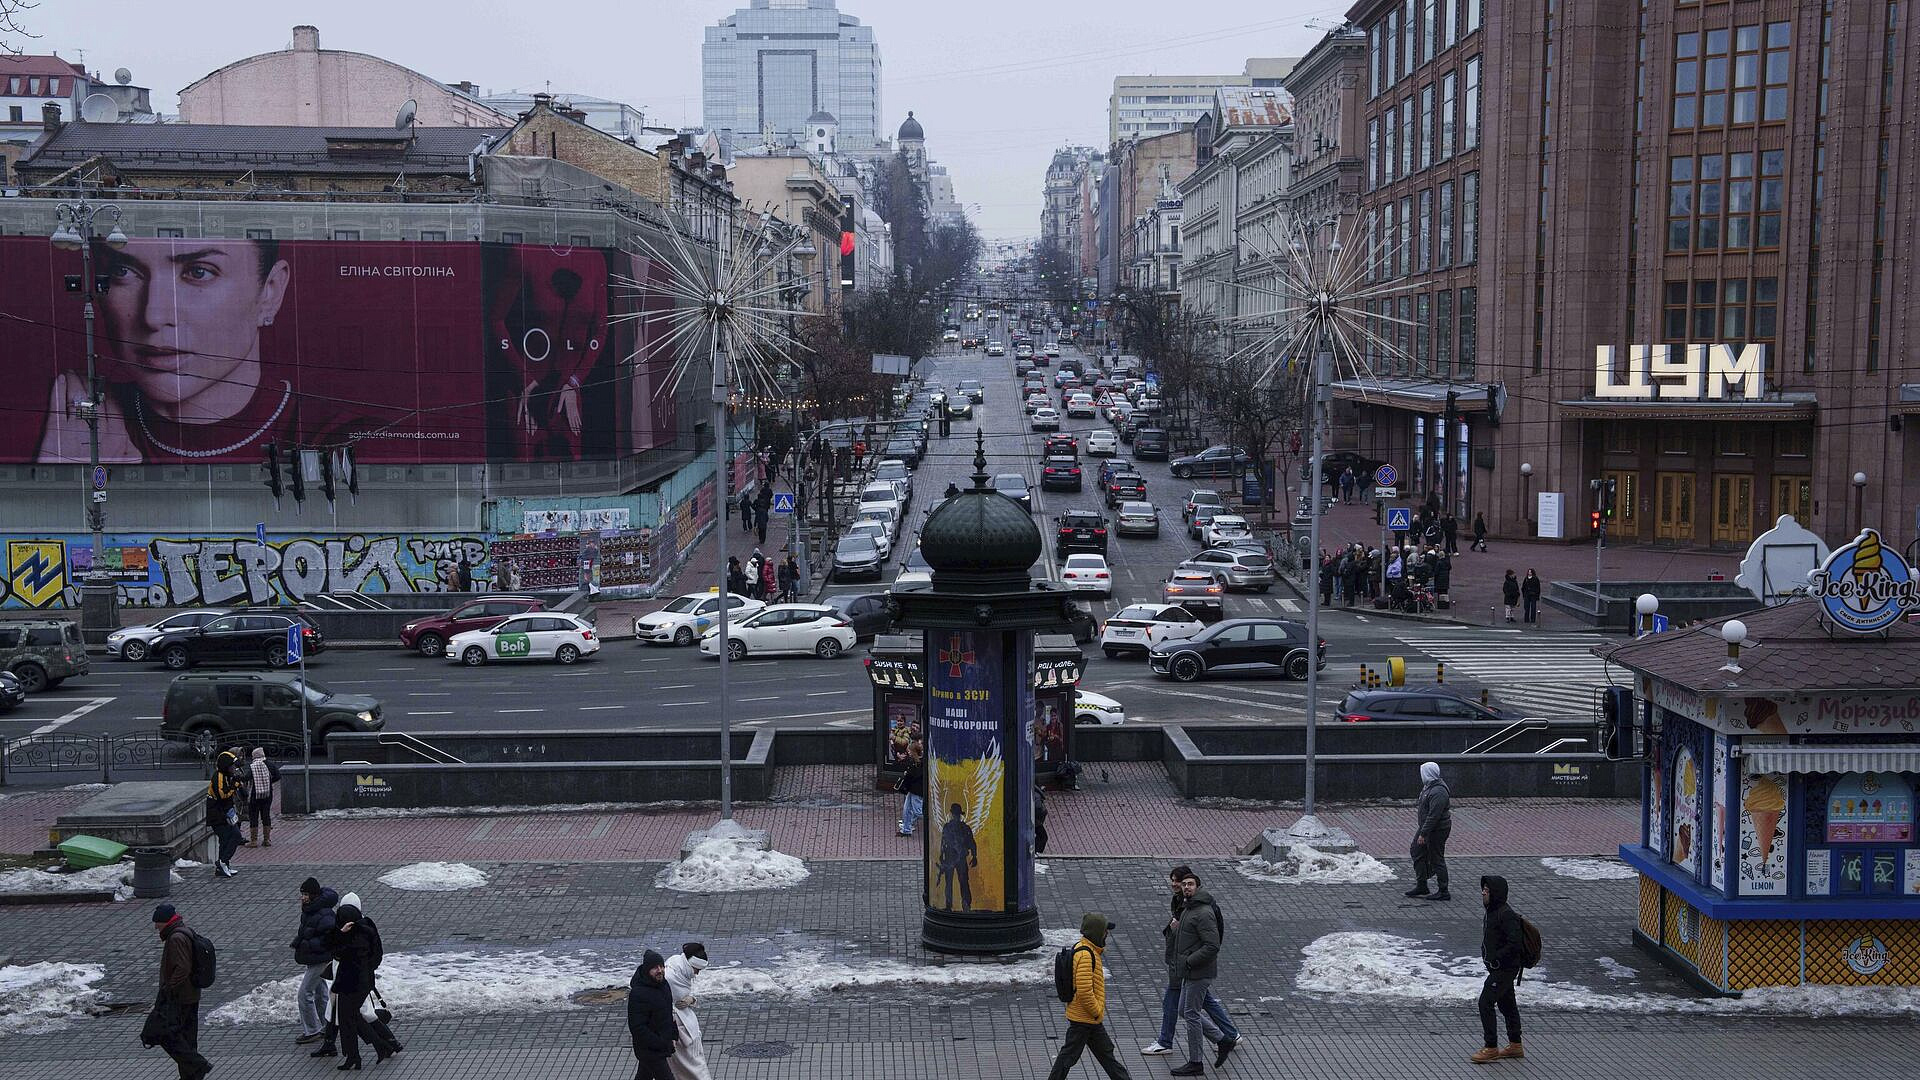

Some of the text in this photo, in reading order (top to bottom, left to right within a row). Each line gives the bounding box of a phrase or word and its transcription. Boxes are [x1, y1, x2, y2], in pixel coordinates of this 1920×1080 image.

[340, 266, 455, 277] ЕЛІНА СВІТОЛІНА
[501, 328, 599, 361] SOLO
[1595, 343, 1766, 398] ЦУМ
[1814, 571, 1919, 605] Ice King
[501, 640, 525, 651] Bolt
[965, 690, 989, 700] ЗСУ!
[946, 708, 967, 718] НАШІ
[1752, 882, 1774, 890] LEMON
